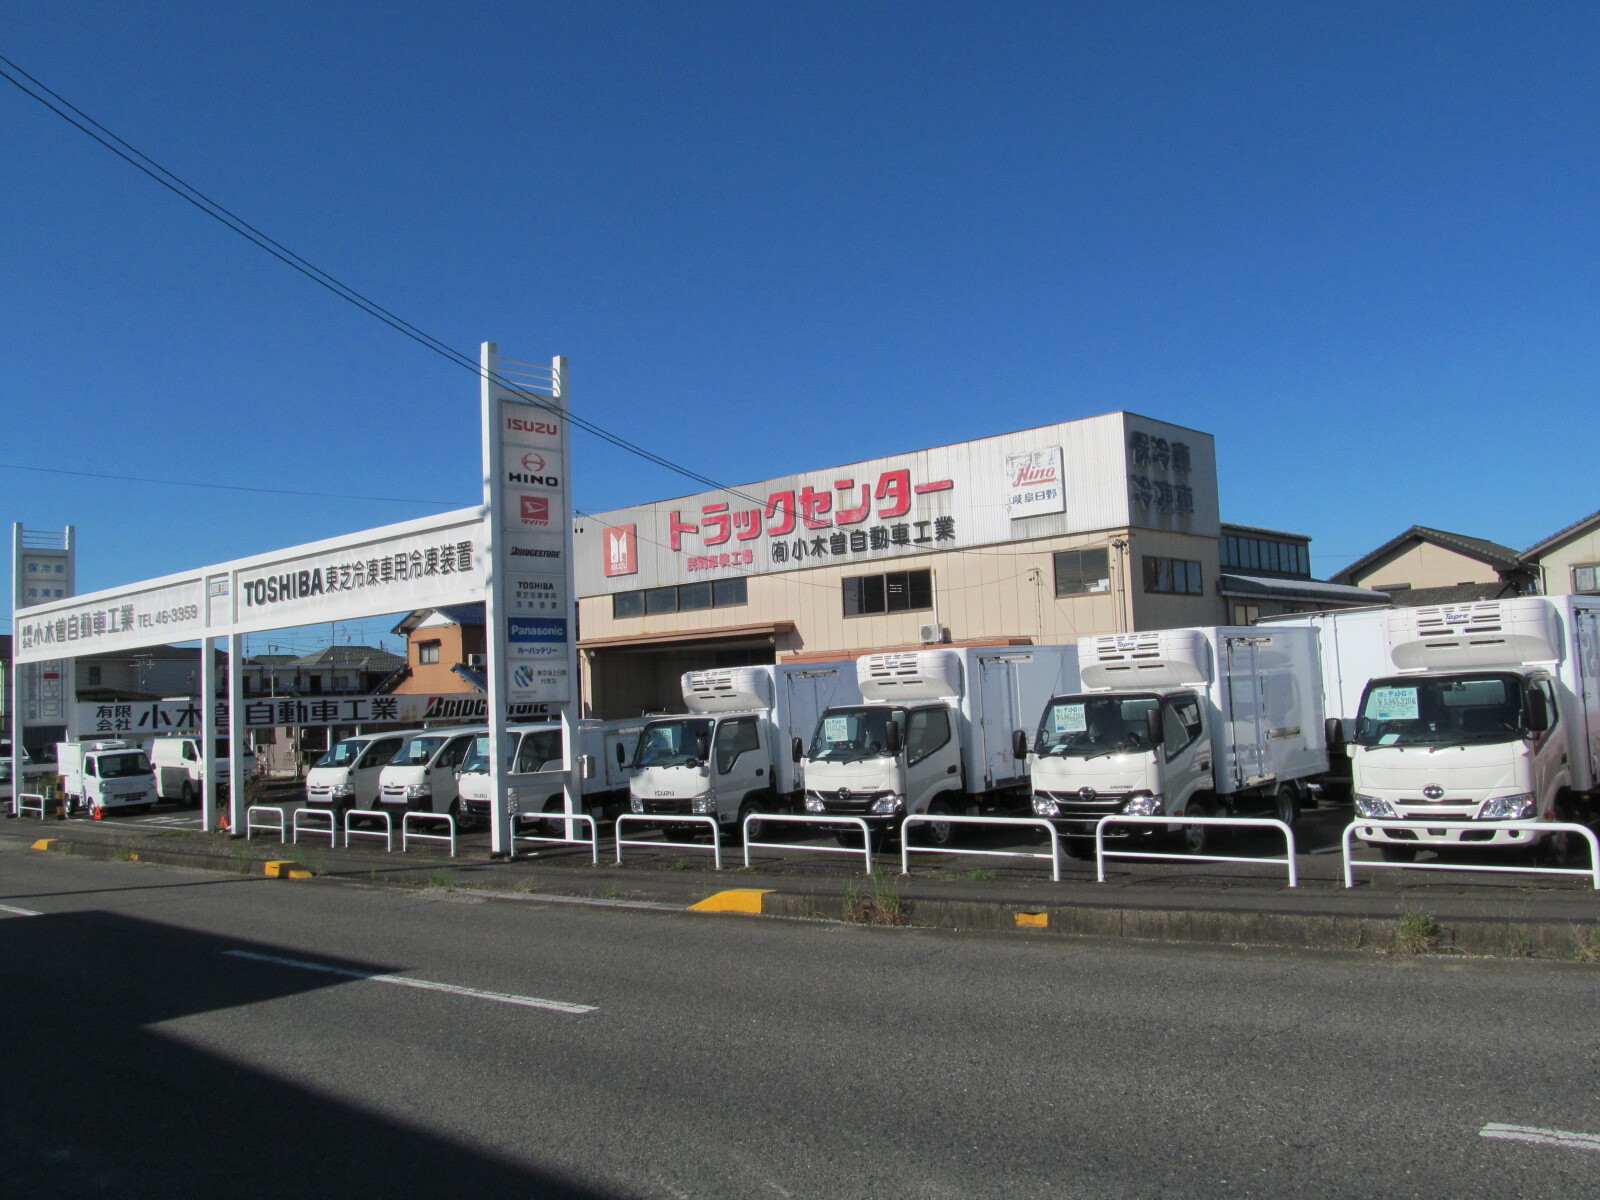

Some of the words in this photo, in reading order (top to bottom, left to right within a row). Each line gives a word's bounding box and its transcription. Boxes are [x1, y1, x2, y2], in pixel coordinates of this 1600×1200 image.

[507, 418, 557, 435] ISUZU
[508, 472, 558, 487] HINO
[1012, 463, 1055, 487] Hino
[1012, 489, 1057, 504] 岐阜日野
[669, 468, 954, 552] トラックセンター
[510, 546, 561, 558] BRIDGESTONE
[28, 563, 64, 574] 保冷車
[243, 567, 324, 607] TOSHIBA
[324, 540, 475, 593] 東芝冷凍車用冷凍装置
[517, 581, 554, 590] TOSHIBA
[27, 588, 64, 598] 冷凍車
[34, 603, 136, 646] 小木曽自動車工業
[138, 613, 154, 628] TEL
[155, 604, 199, 625] 46-3359
[511, 625, 563, 636] Panasonic
[518, 646, 557, 655] カーバッテリー
[96, 706, 132, 718] 有限
[138, 697, 398, 729] 小木曽自動車工業
[96, 719, 132, 732] 会社
